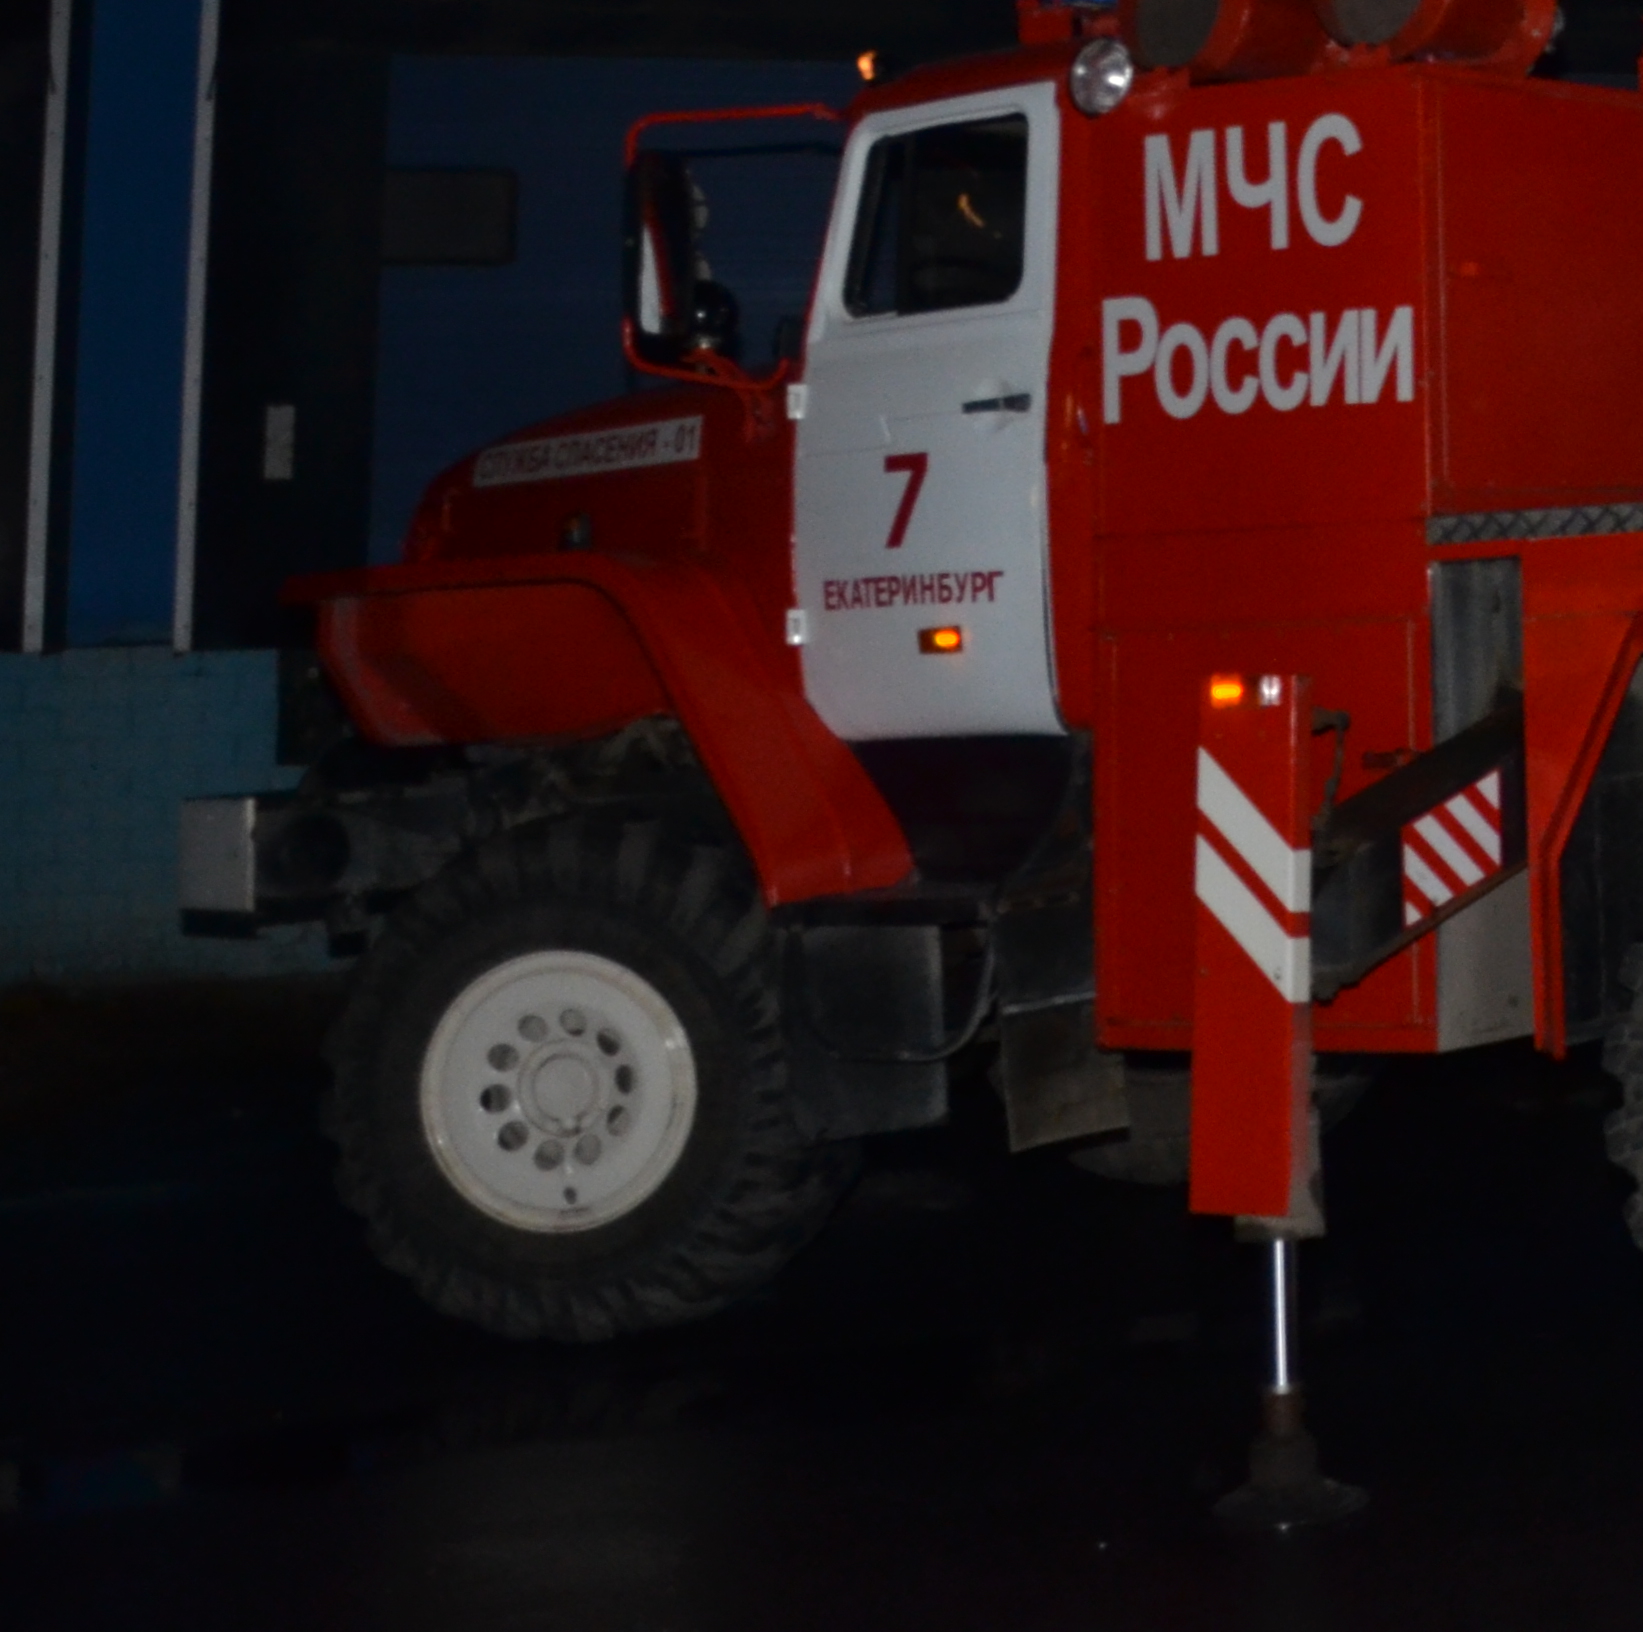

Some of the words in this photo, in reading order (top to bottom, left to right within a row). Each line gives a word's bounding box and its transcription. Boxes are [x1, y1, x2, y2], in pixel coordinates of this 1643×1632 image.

[1142, 110, 1365, 263] МЧС
[1101, 292, 1416, 426] России
[674, 423, 696, 454] 01
[884, 452, 928, 548] 7
[823, 570, 1004, 611] ЕКАТЕРИНБУРГ
